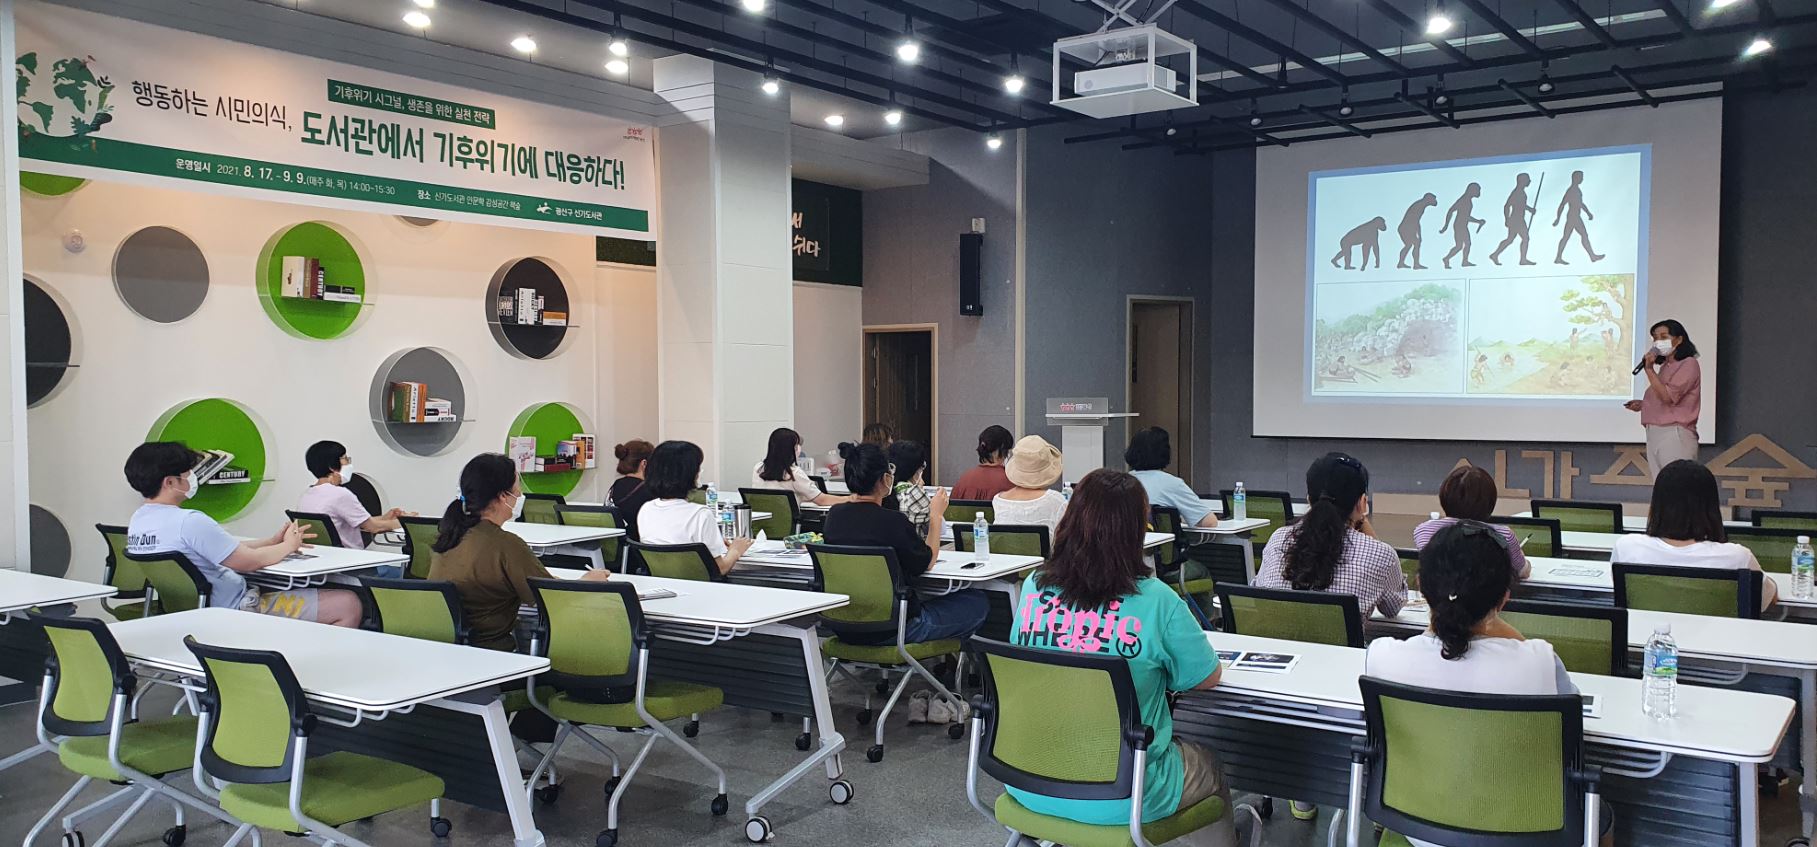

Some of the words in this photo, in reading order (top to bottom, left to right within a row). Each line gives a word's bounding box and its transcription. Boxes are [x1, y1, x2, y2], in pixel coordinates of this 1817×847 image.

[335, 85, 372, 103] 기후위기
[375, 92, 405, 110] 시그널,
[407, 98, 433, 114] 생존을
[436, 104, 452, 118] 위한
[455, 107, 471, 121] 실천
[474, 110, 490, 124] 전략
[132, 80, 209, 117] 행동하는
[216, 95, 293, 131] 시민의식,
[301, 111, 424, 163] 도서관에서
[433, 131, 538, 180] 기후위기에
[544, 150, 625, 191] 대응하다!
[176, 158, 211, 173] 운영일시
[417, 189, 431, 200] 장소
[1021, 593, 1142, 655] Tropic
